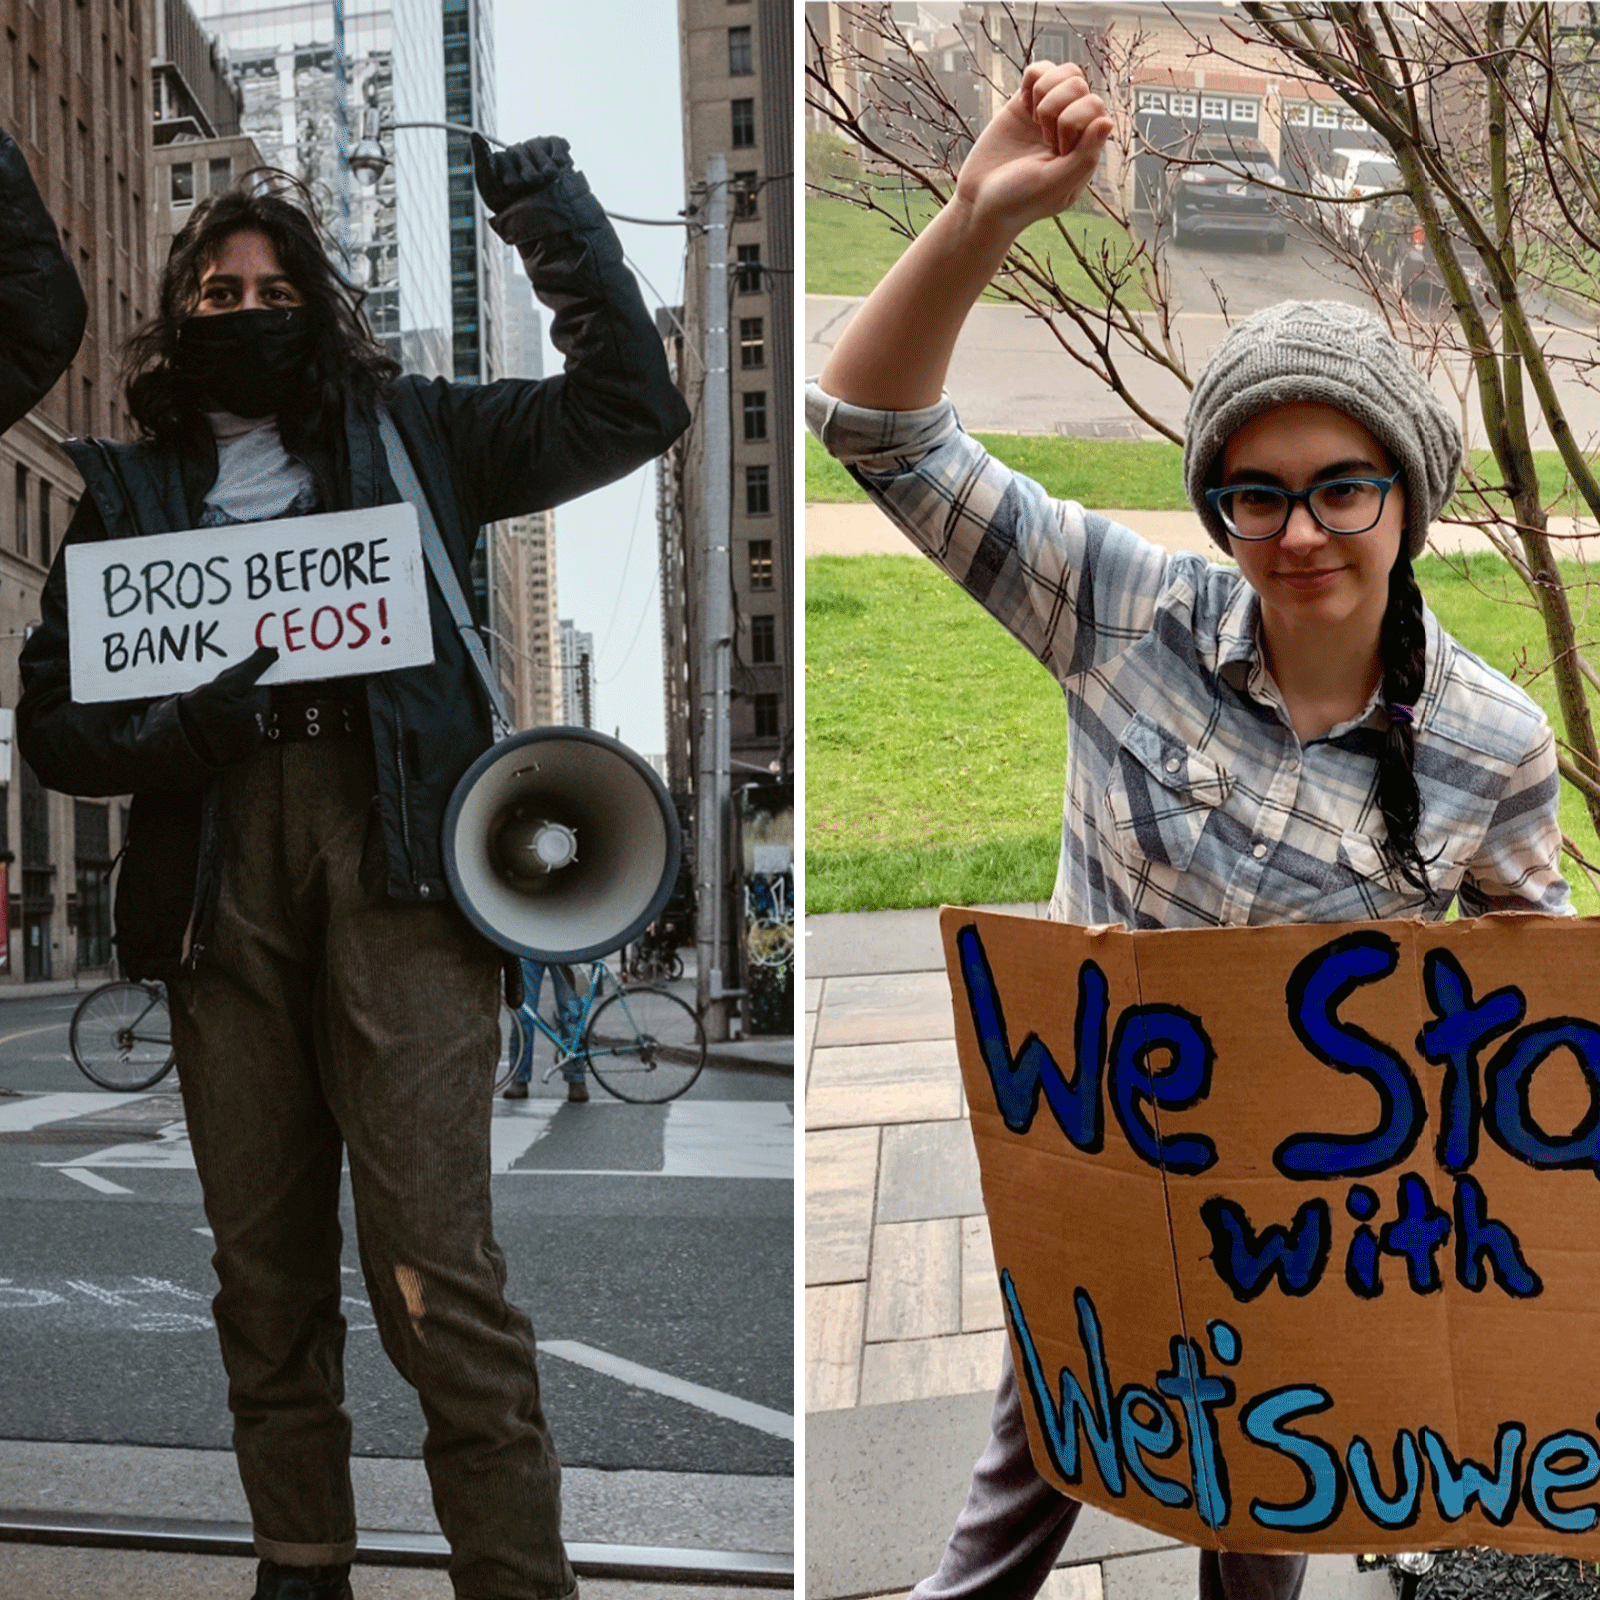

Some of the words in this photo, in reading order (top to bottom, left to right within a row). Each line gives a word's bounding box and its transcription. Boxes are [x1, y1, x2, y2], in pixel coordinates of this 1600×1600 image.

[101, 556, 232, 618] BROS
[244, 538, 391, 600] BEFORE
[102, 620, 228, 673] BANK
[254, 597, 392, 652] CEOS!
[956, 923, 1218, 1176] We
[1200, 1172, 1544, 1302] with
